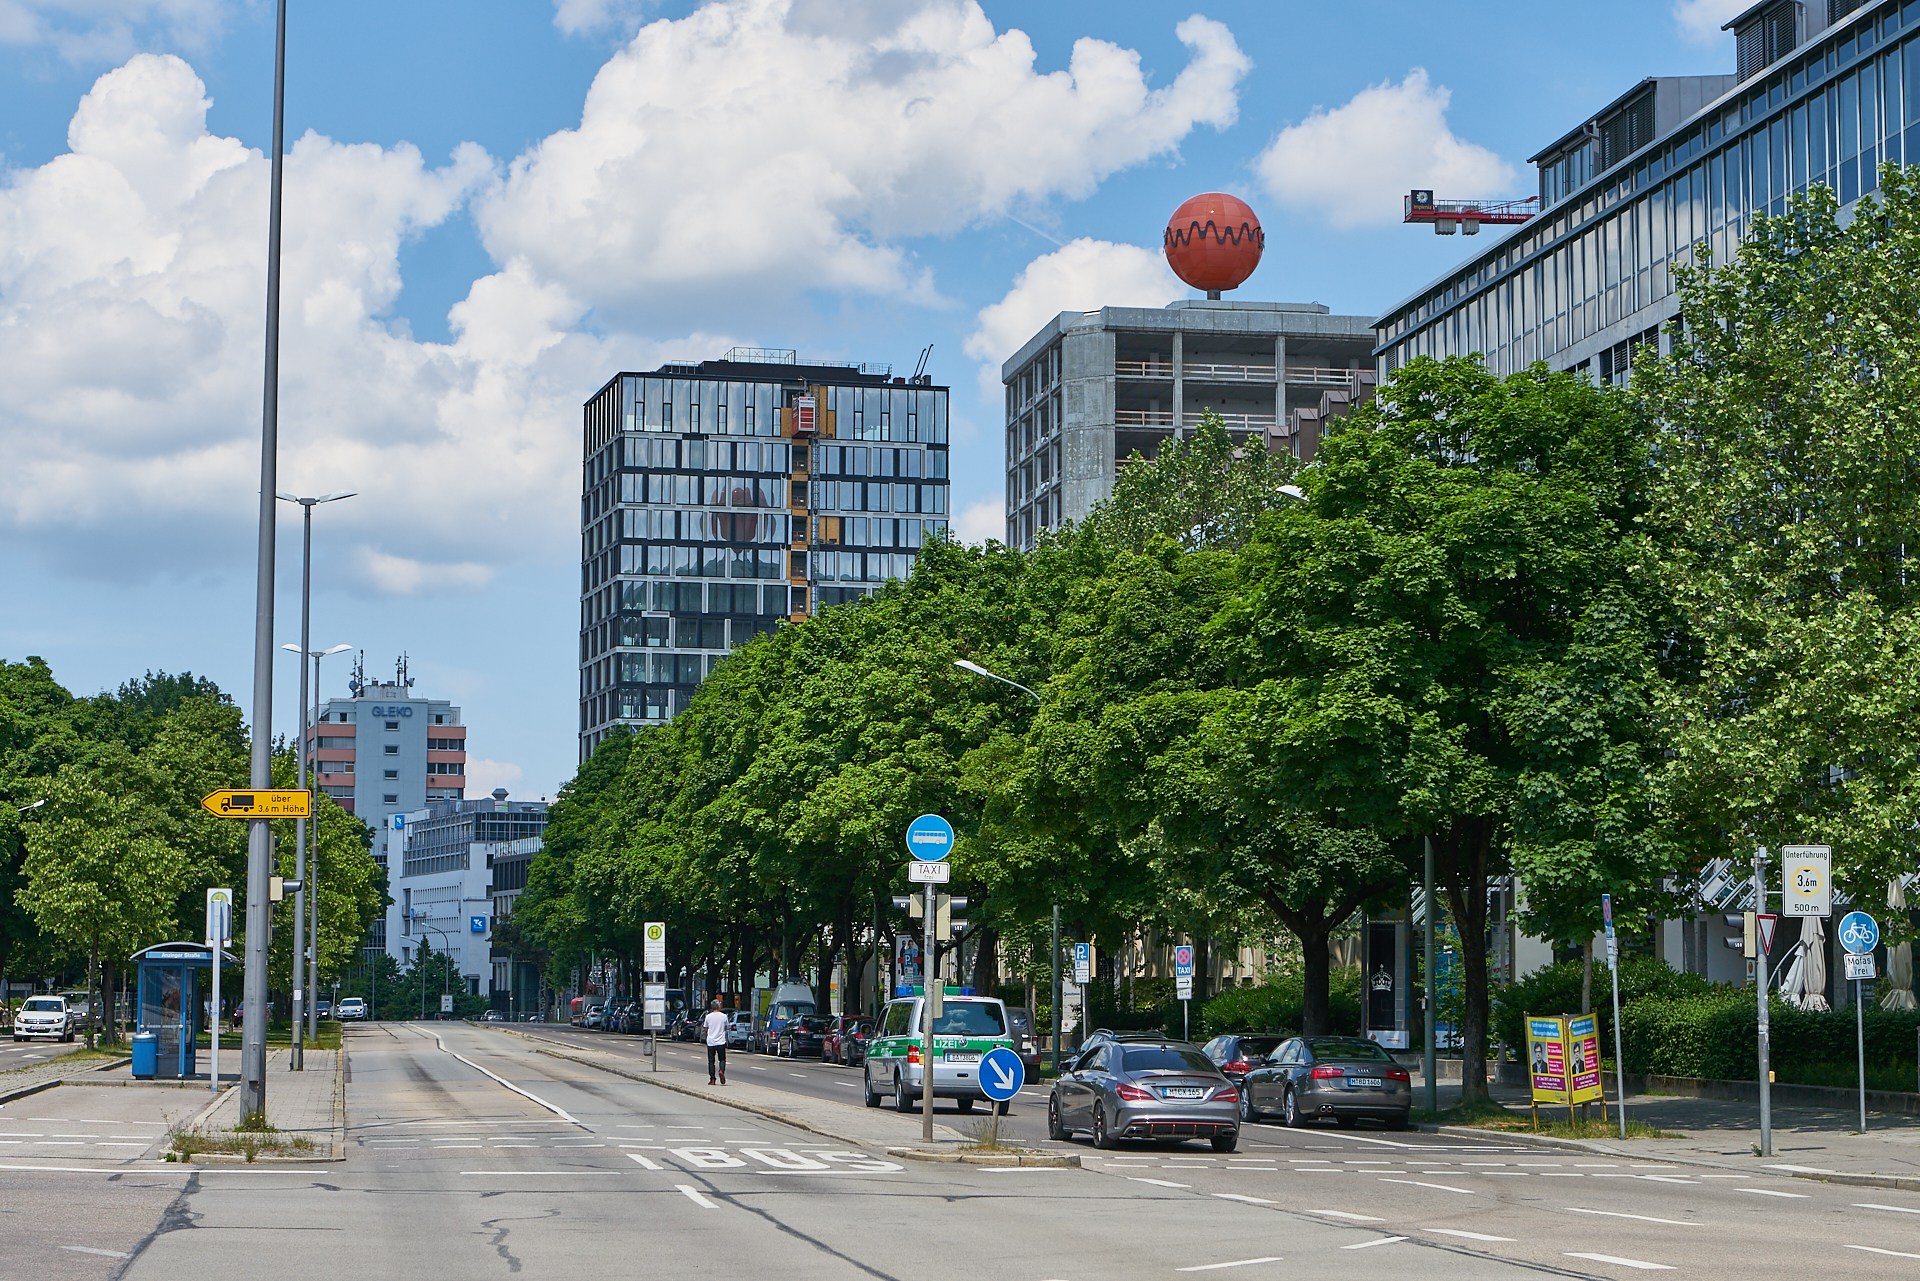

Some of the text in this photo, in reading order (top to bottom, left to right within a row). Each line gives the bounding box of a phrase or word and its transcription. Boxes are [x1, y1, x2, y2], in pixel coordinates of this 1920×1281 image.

[371, 705, 413, 717] GLEKO
[1785, 851, 1828, 860] Unterführung
[918, 864, 941, 874] TAXI
[1847, 957, 1871, 966] Mofas
[1178, 966, 1190, 974] TAXI
[667, 1148, 905, 1171] BUS
